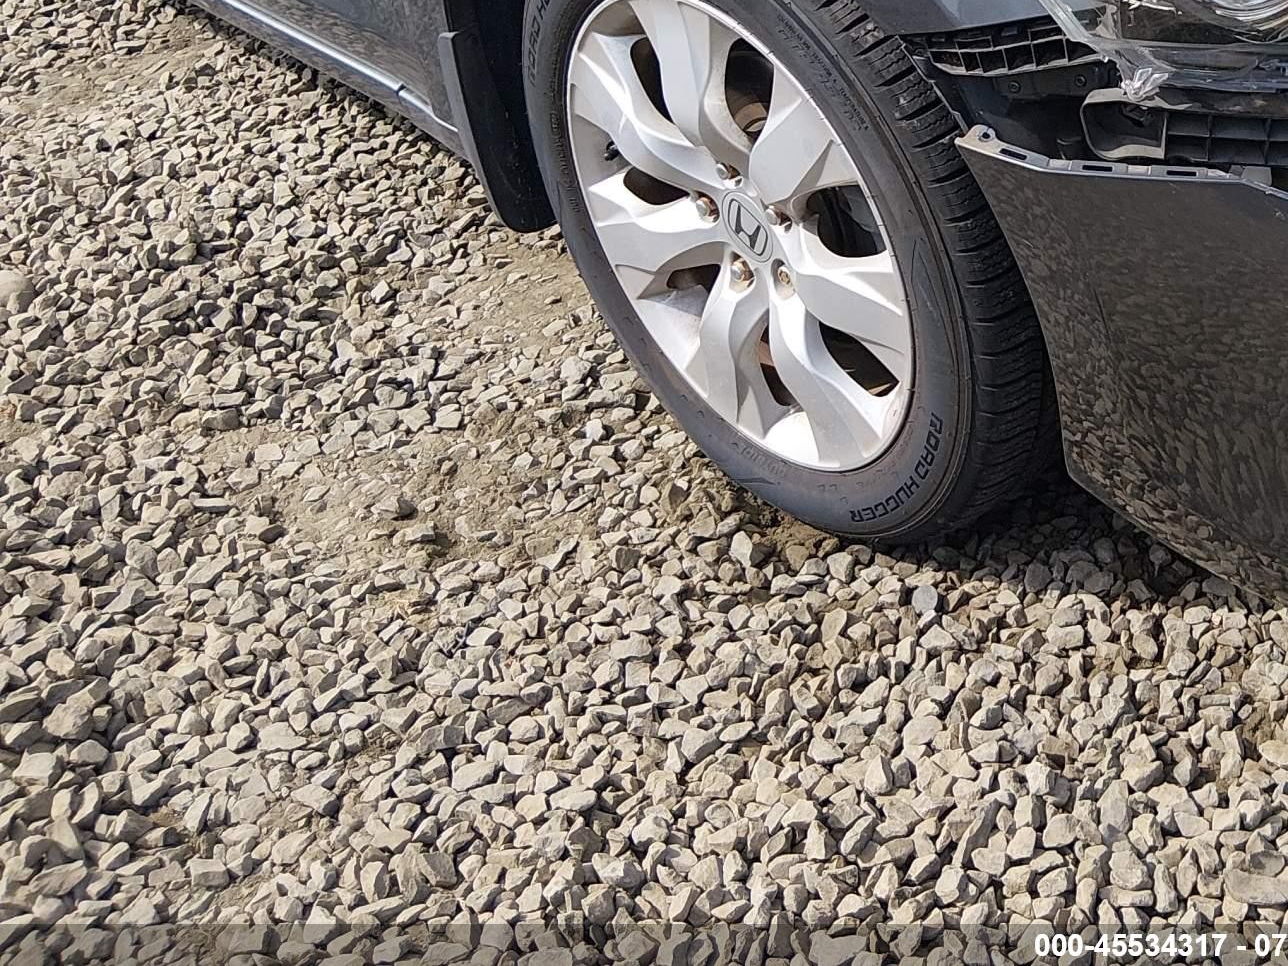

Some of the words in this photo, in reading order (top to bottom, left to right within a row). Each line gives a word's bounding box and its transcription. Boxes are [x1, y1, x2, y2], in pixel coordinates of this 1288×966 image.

[527, 16, 541, 87] ROAD
[914, 412, 944, 481] ROAD
[849, 475, 920, 523] HUGGER
